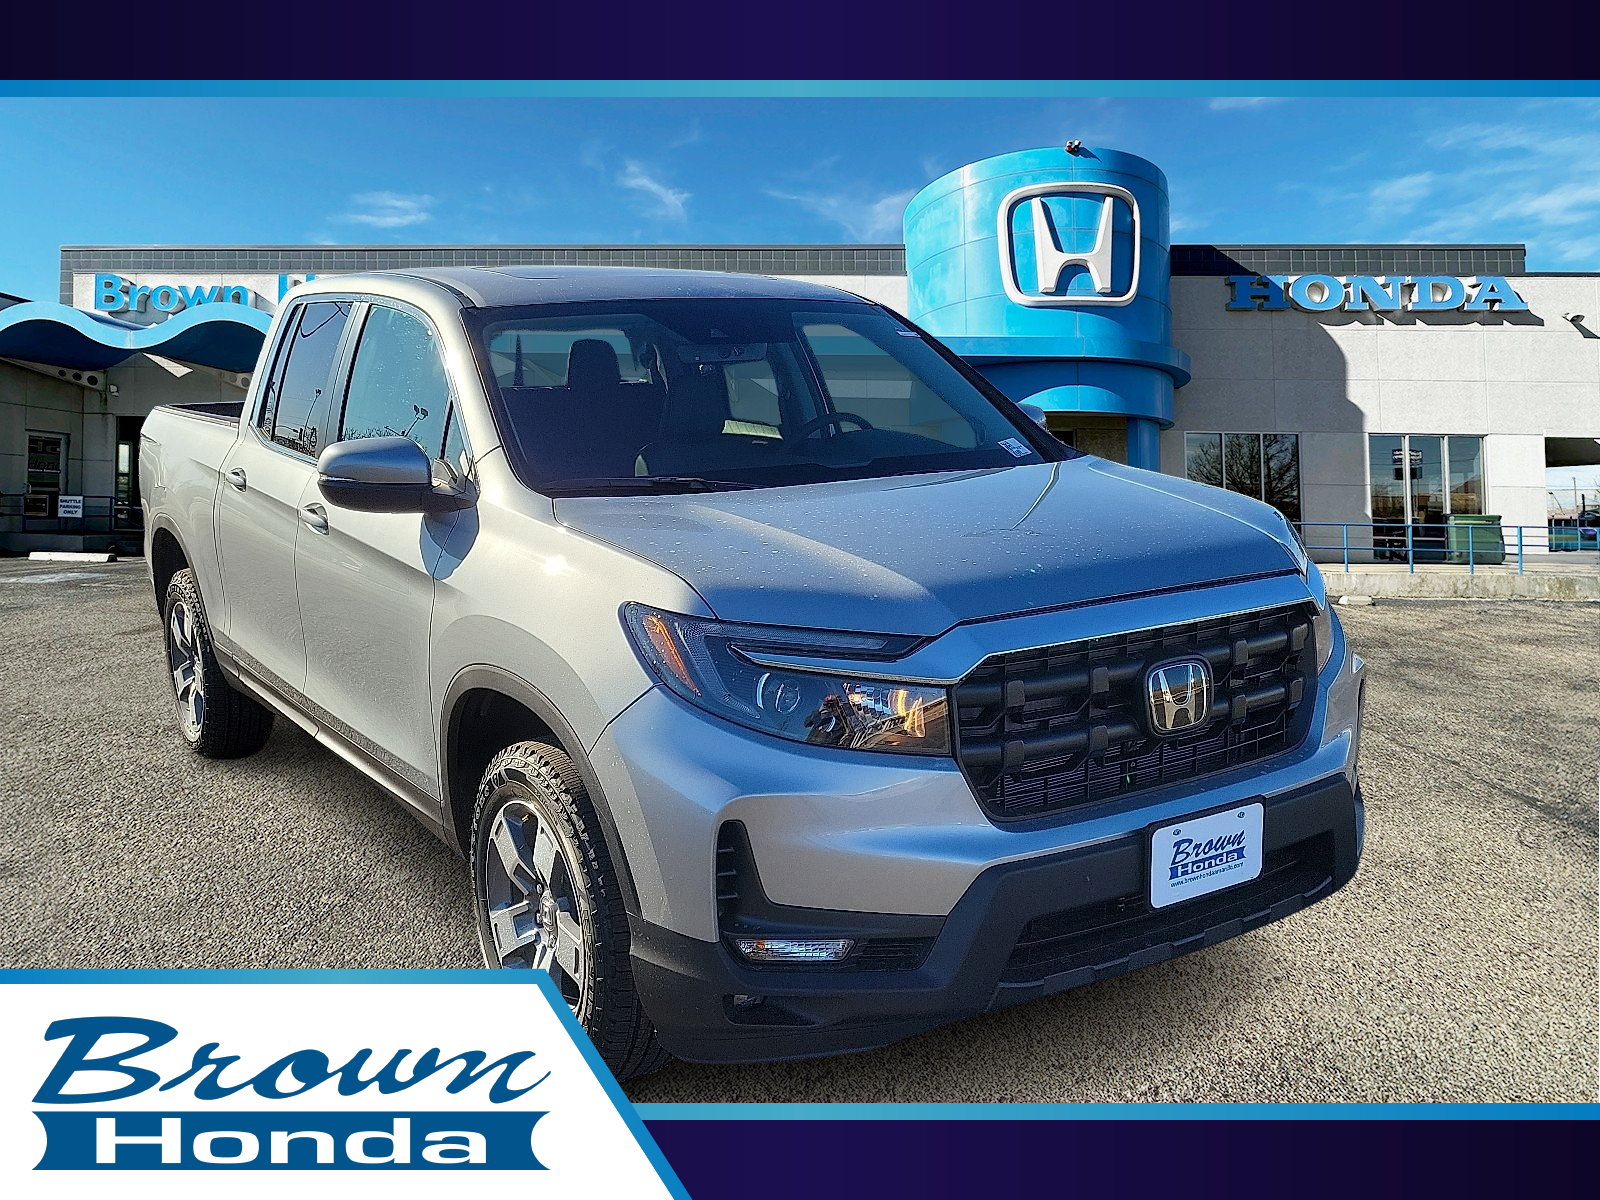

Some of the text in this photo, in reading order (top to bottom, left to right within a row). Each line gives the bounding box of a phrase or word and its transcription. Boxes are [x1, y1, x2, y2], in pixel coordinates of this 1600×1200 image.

[94, 273, 251, 312] Brown
[1225, 273, 1529, 312] HONDA
[1170, 829, 1246, 867] Brown
[1177, 851, 1238, 877] Honda
